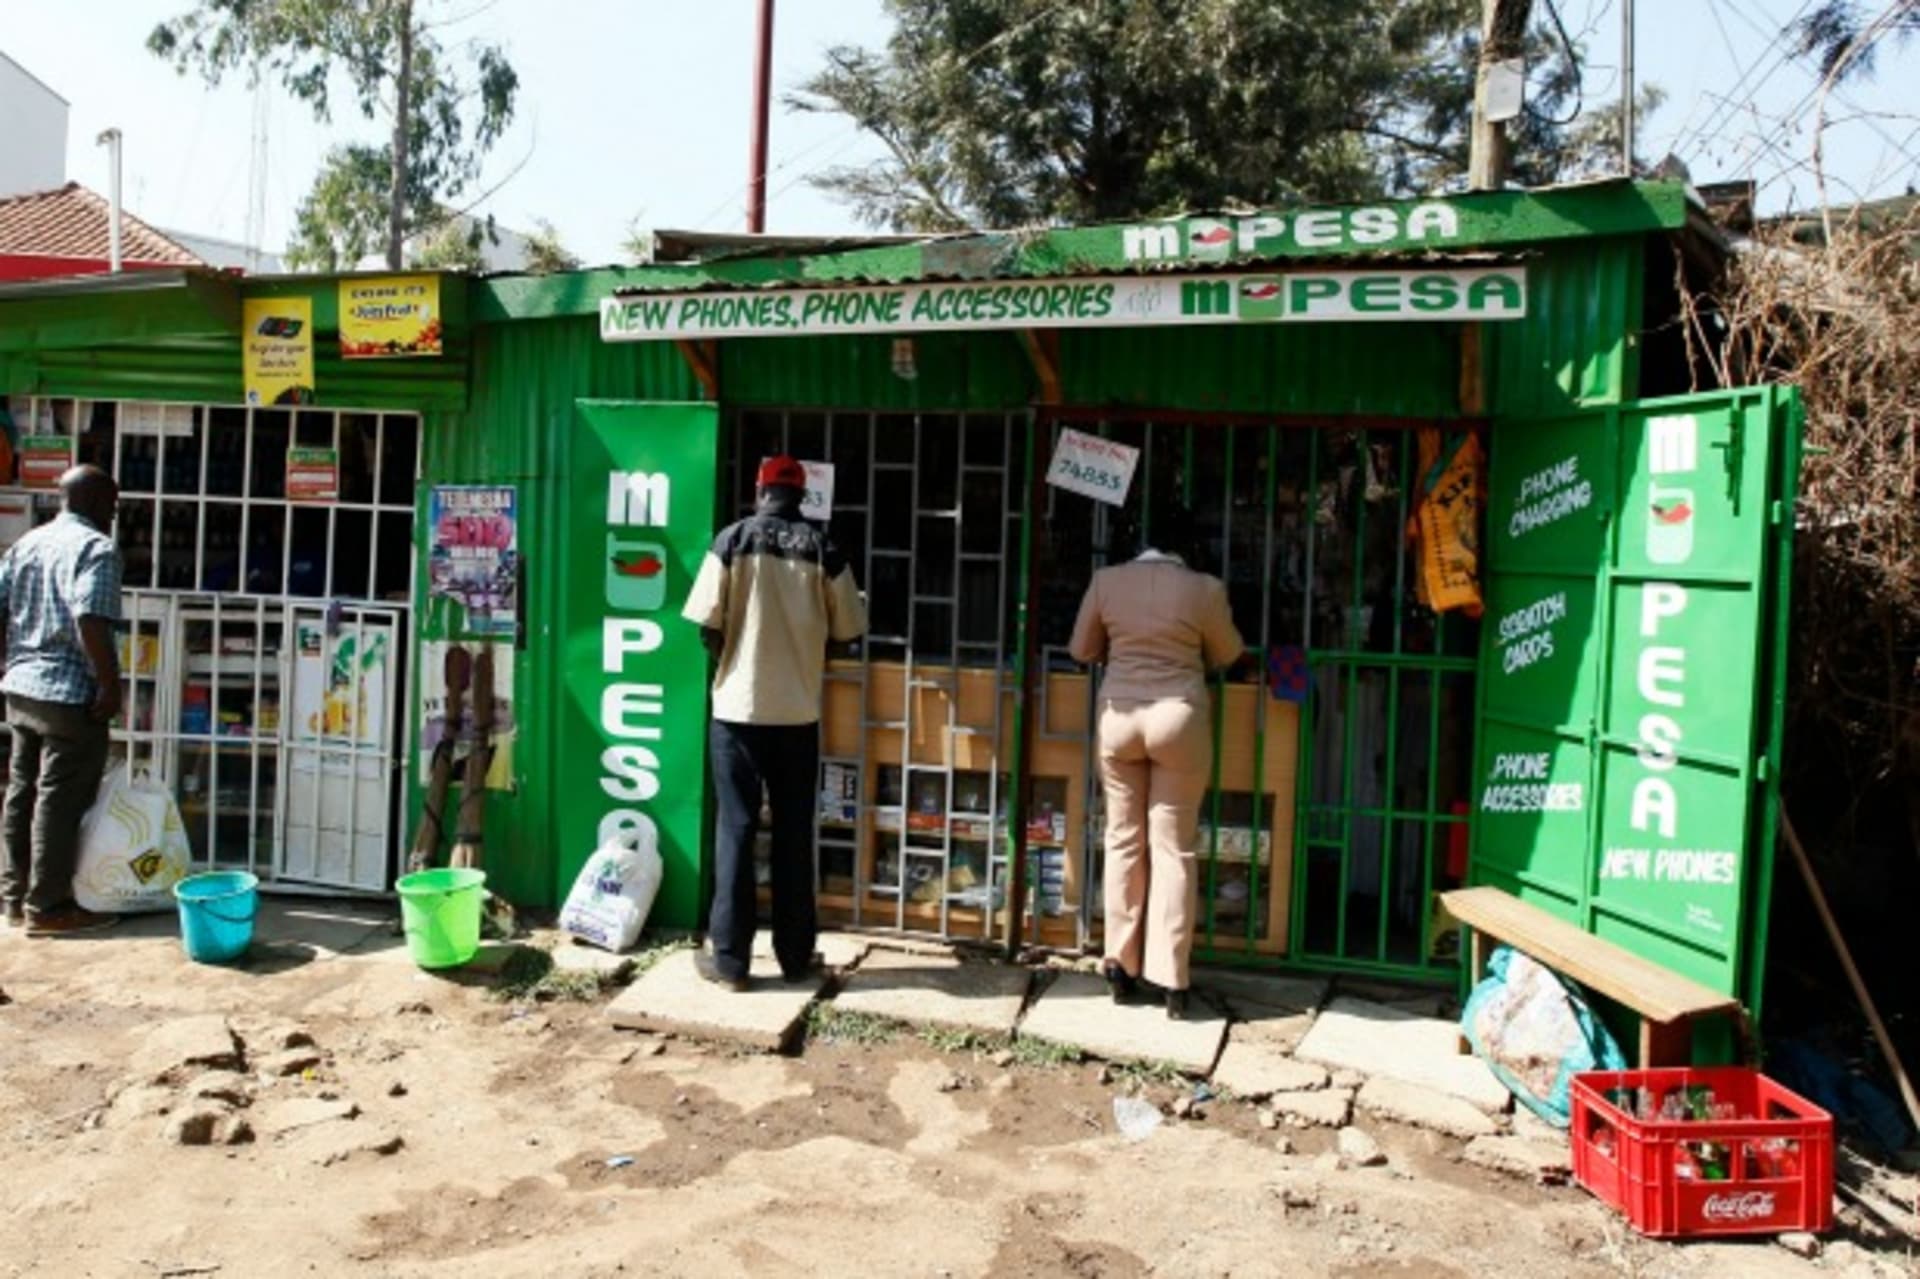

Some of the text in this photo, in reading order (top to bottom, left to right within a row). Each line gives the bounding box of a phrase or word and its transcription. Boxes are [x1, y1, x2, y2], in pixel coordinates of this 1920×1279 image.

[603, 299, 672, 331] NEW
[802, 289, 906, 326] PHONE
[911, 283, 1115, 321] ACCESSORIES
[1521, 455, 1579, 504] PHONE
[1499, 591, 1566, 639] SCRATCH
[1491, 752, 1550, 781] PHONE
[1481, 783, 1583, 813] ACCESSORIES
[1600, 847, 1736, 885] NEW PHONES
